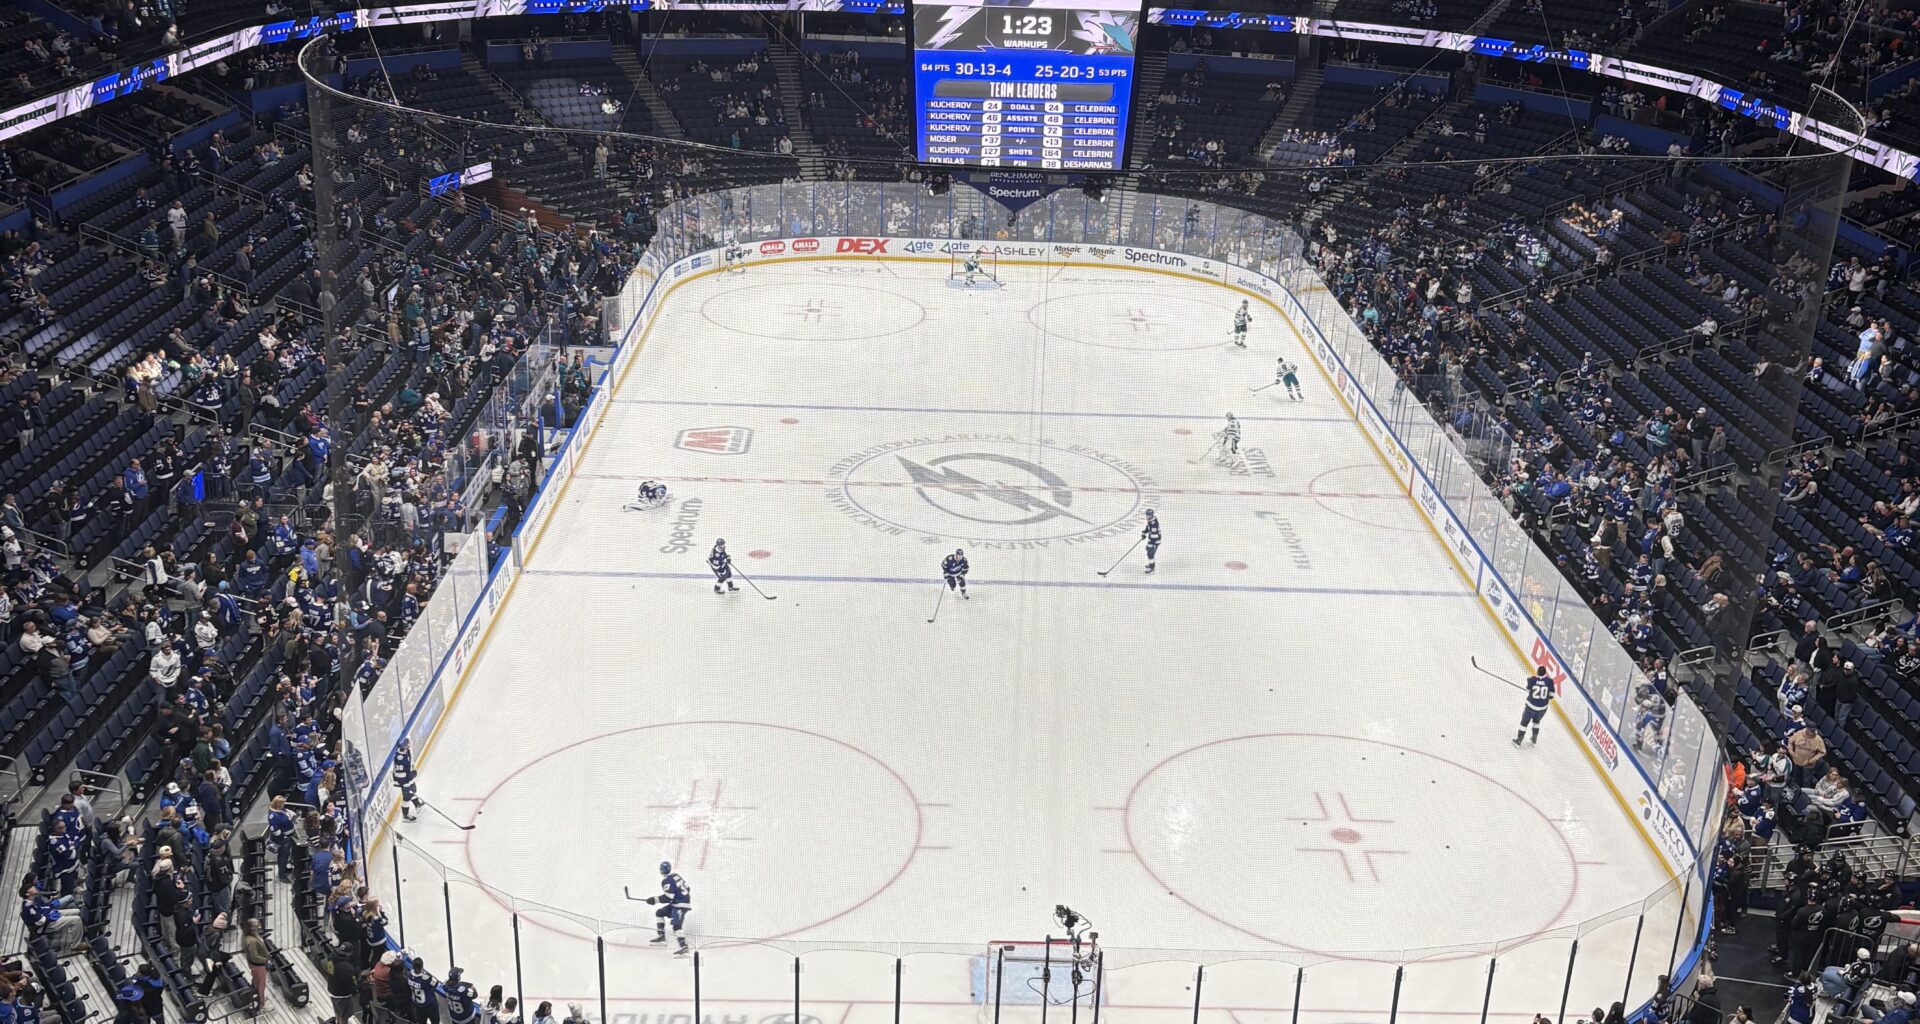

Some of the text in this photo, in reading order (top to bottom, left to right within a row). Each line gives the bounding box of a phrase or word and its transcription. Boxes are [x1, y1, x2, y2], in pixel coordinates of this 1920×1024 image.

[1002, 15, 1052, 35] 1:23
[1230, 18, 1285, 26] LIGHTNING
[1004, 40, 1048, 49] WARMUPS
[1481, 43, 1507, 51] TAMPA
[935, 64, 950, 72] PTS
[955, 63, 1011, 76] 30-13-4
[1035, 65, 1095, 78] 25-20-3
[1111, 69, 1127, 77] PTS
[990, 82, 1057, 99] TEAM LEADERS
[930, 101, 972, 109] KUCHEROV
[1075, 105, 1115, 113] CELEBRINI
[930, 113, 971, 121] KUCHEROV
[930, 124, 971, 132] KUCHEROV
[1074, 128, 1114, 136] CELEBRINI
[930, 135, 957, 143] MOSER
[1074, 139, 1114, 147] CELEBRINI
[989, 186, 1039, 198] Spectrum
[836, 238, 891, 254] DEX
[994, 245, 1046, 257] ASHLEY
[1125, 248, 1183, 268] Spectrum
[660, 497, 703, 554] Spectrum
[1531, 637, 1568, 697] DEX
[1532, 685, 1548, 699] 20
[1591, 719, 1618, 760] HUGHES
[1654, 804, 1685, 857] TECO
